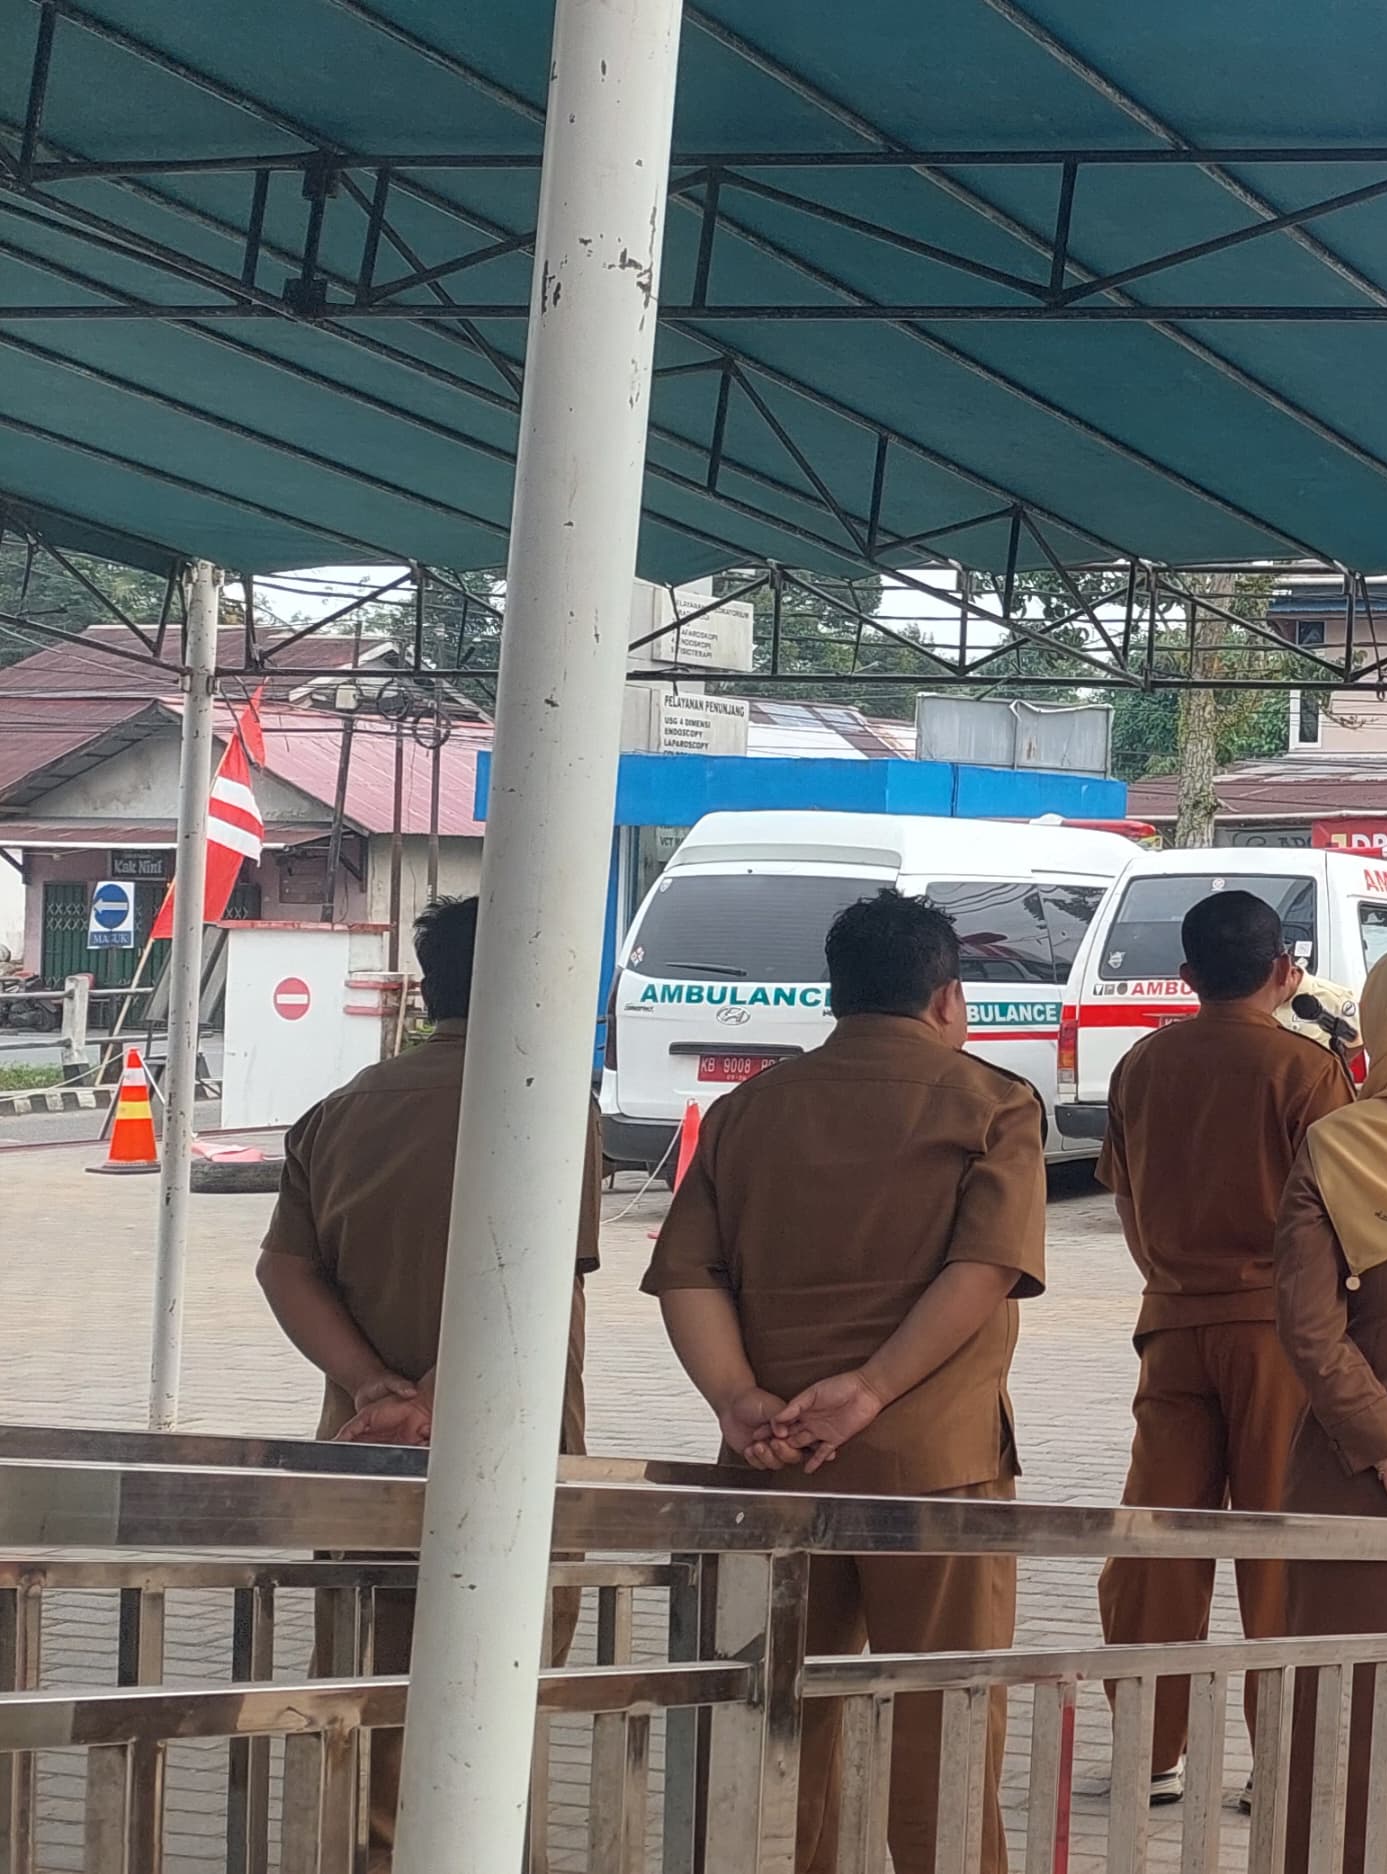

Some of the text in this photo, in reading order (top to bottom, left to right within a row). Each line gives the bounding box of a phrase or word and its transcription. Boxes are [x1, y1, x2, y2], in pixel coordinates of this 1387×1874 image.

[664, 695, 745, 717] PELAYANAN PENUNJANG
[684, 718, 711, 728] DIMENSI
[664, 727, 703, 738] ENDOSCOPY
[663, 738, 710, 750] LAPAROSCOPY
[966, 1003, 1057, 1022] BULANCE
[701, 1057, 715, 1072] KB
[723, 1058, 751, 1074] 9008
